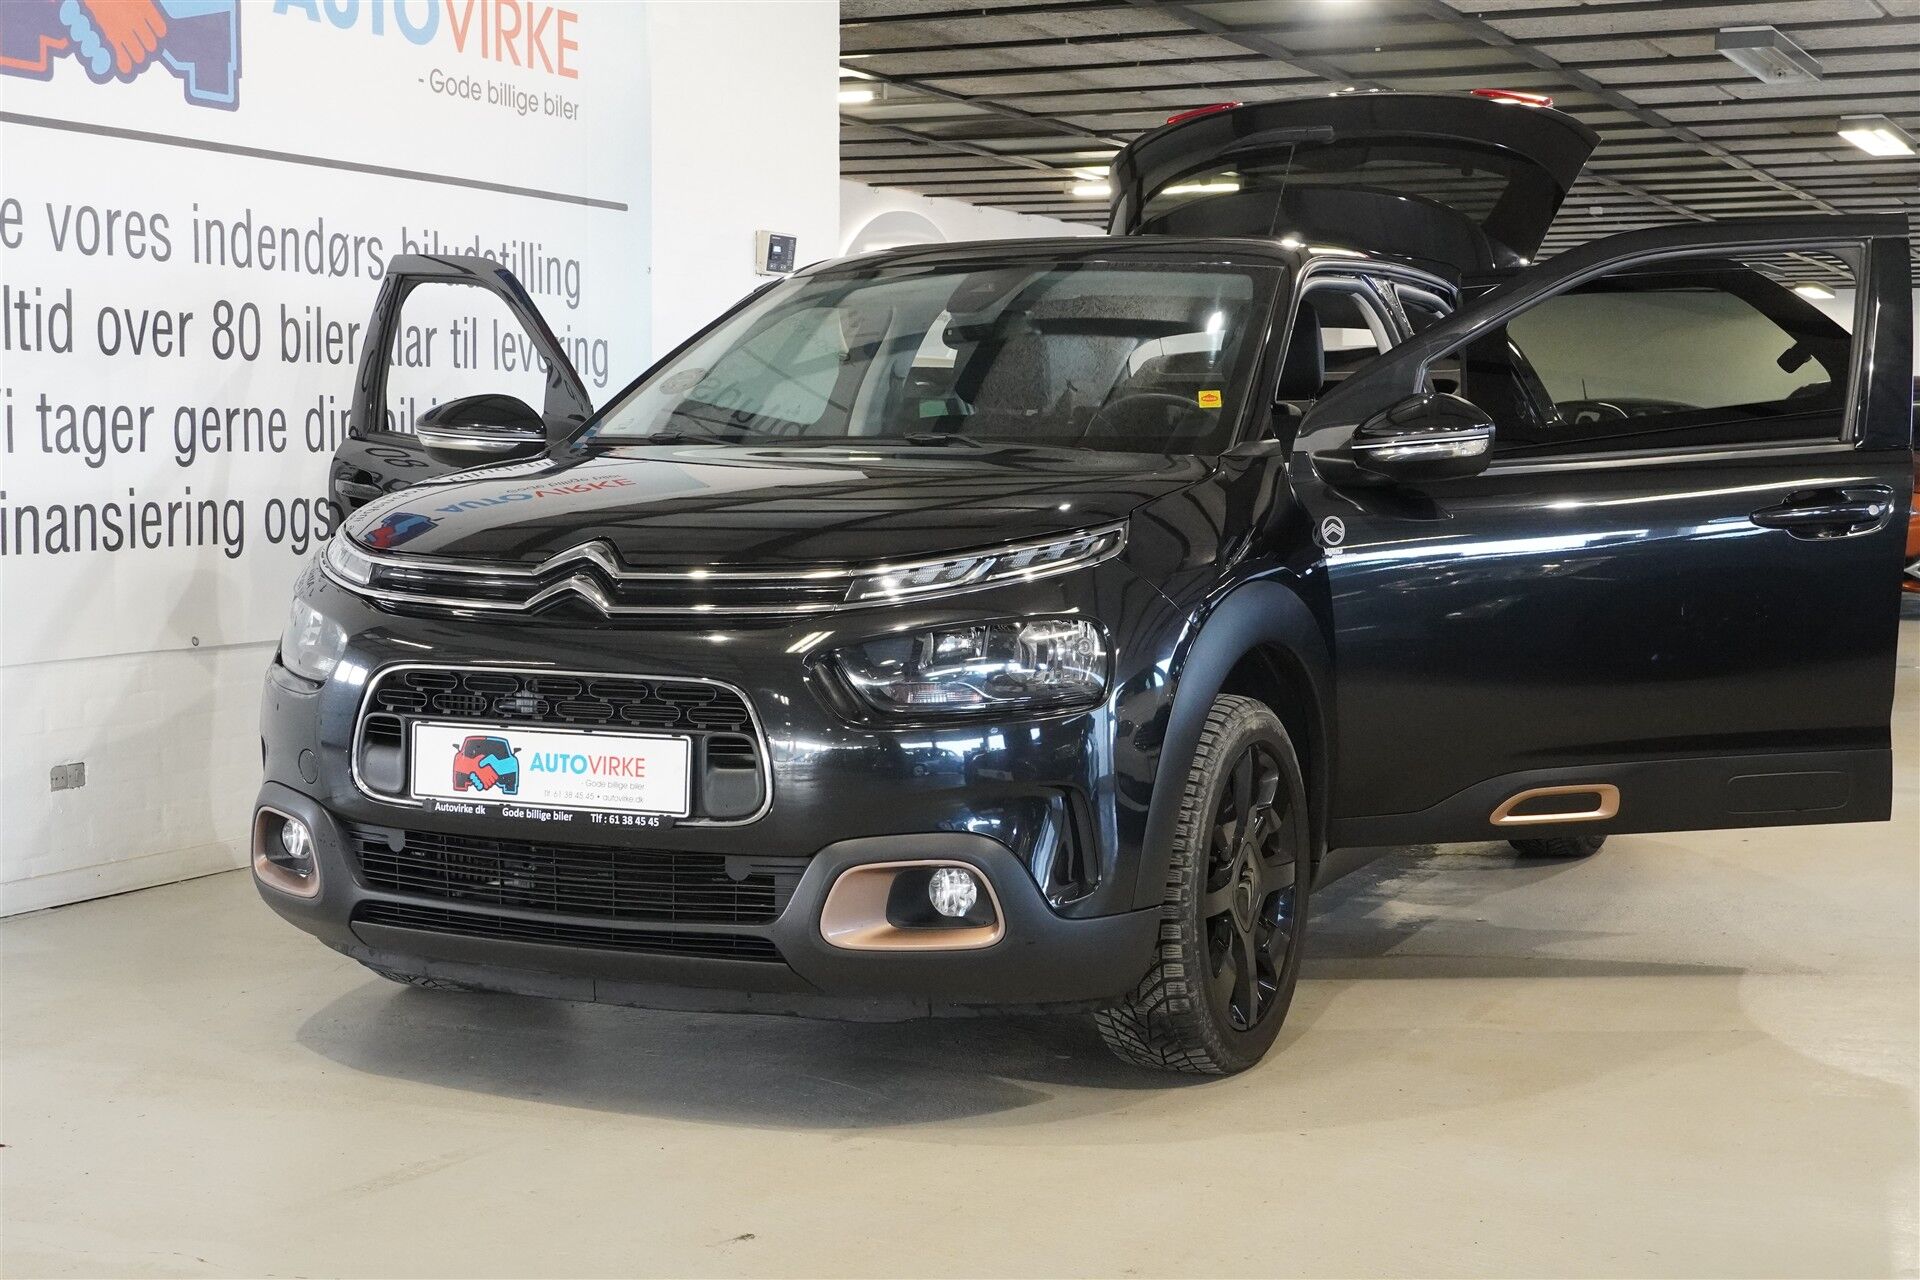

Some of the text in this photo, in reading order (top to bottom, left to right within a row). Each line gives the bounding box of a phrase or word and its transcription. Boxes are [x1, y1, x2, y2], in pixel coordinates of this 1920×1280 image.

[273, 0, 580, 79] OVIRKE
[430, 68, 482, 101] Gode
[488, 80, 539, 116] billige
[545, 92, 579, 120] biler
[46, 203, 172, 262] vores
[193, 203, 385, 281] indendørs
[402, 226, 580, 309] bildtilling
[3, 284, 73, 353] ltid
[97, 306, 193, 357] over
[212, 300, 261, 361] 80
[280, 303, 360, 365] biler
[390, 309, 437, 367] lar
[450, 317, 477, 369] til
[36, 393, 155, 469] tager
[174, 406, 287, 468] gerne
[530, 752, 645, 778] AUTOVIRKE
[585, 779, 606, 788] Gode
[607, 781, 628, 791] billige
[629, 783, 645, 791] biler
[502, 807, 524, 818] Gode
[526, 809, 551, 822] billige
[553, 810, 573, 822] biler
[609, 815, 620, 825] 61
[621, 815, 633, 826] 38
[634, 816, 646, 826] 45
[647, 817, 660, 827] 45
[553, 790, 561, 798] 61
[565, 791, 573, 799] 38
[574, 792, 584, 800] 45
[585, 792, 595, 801] 45
